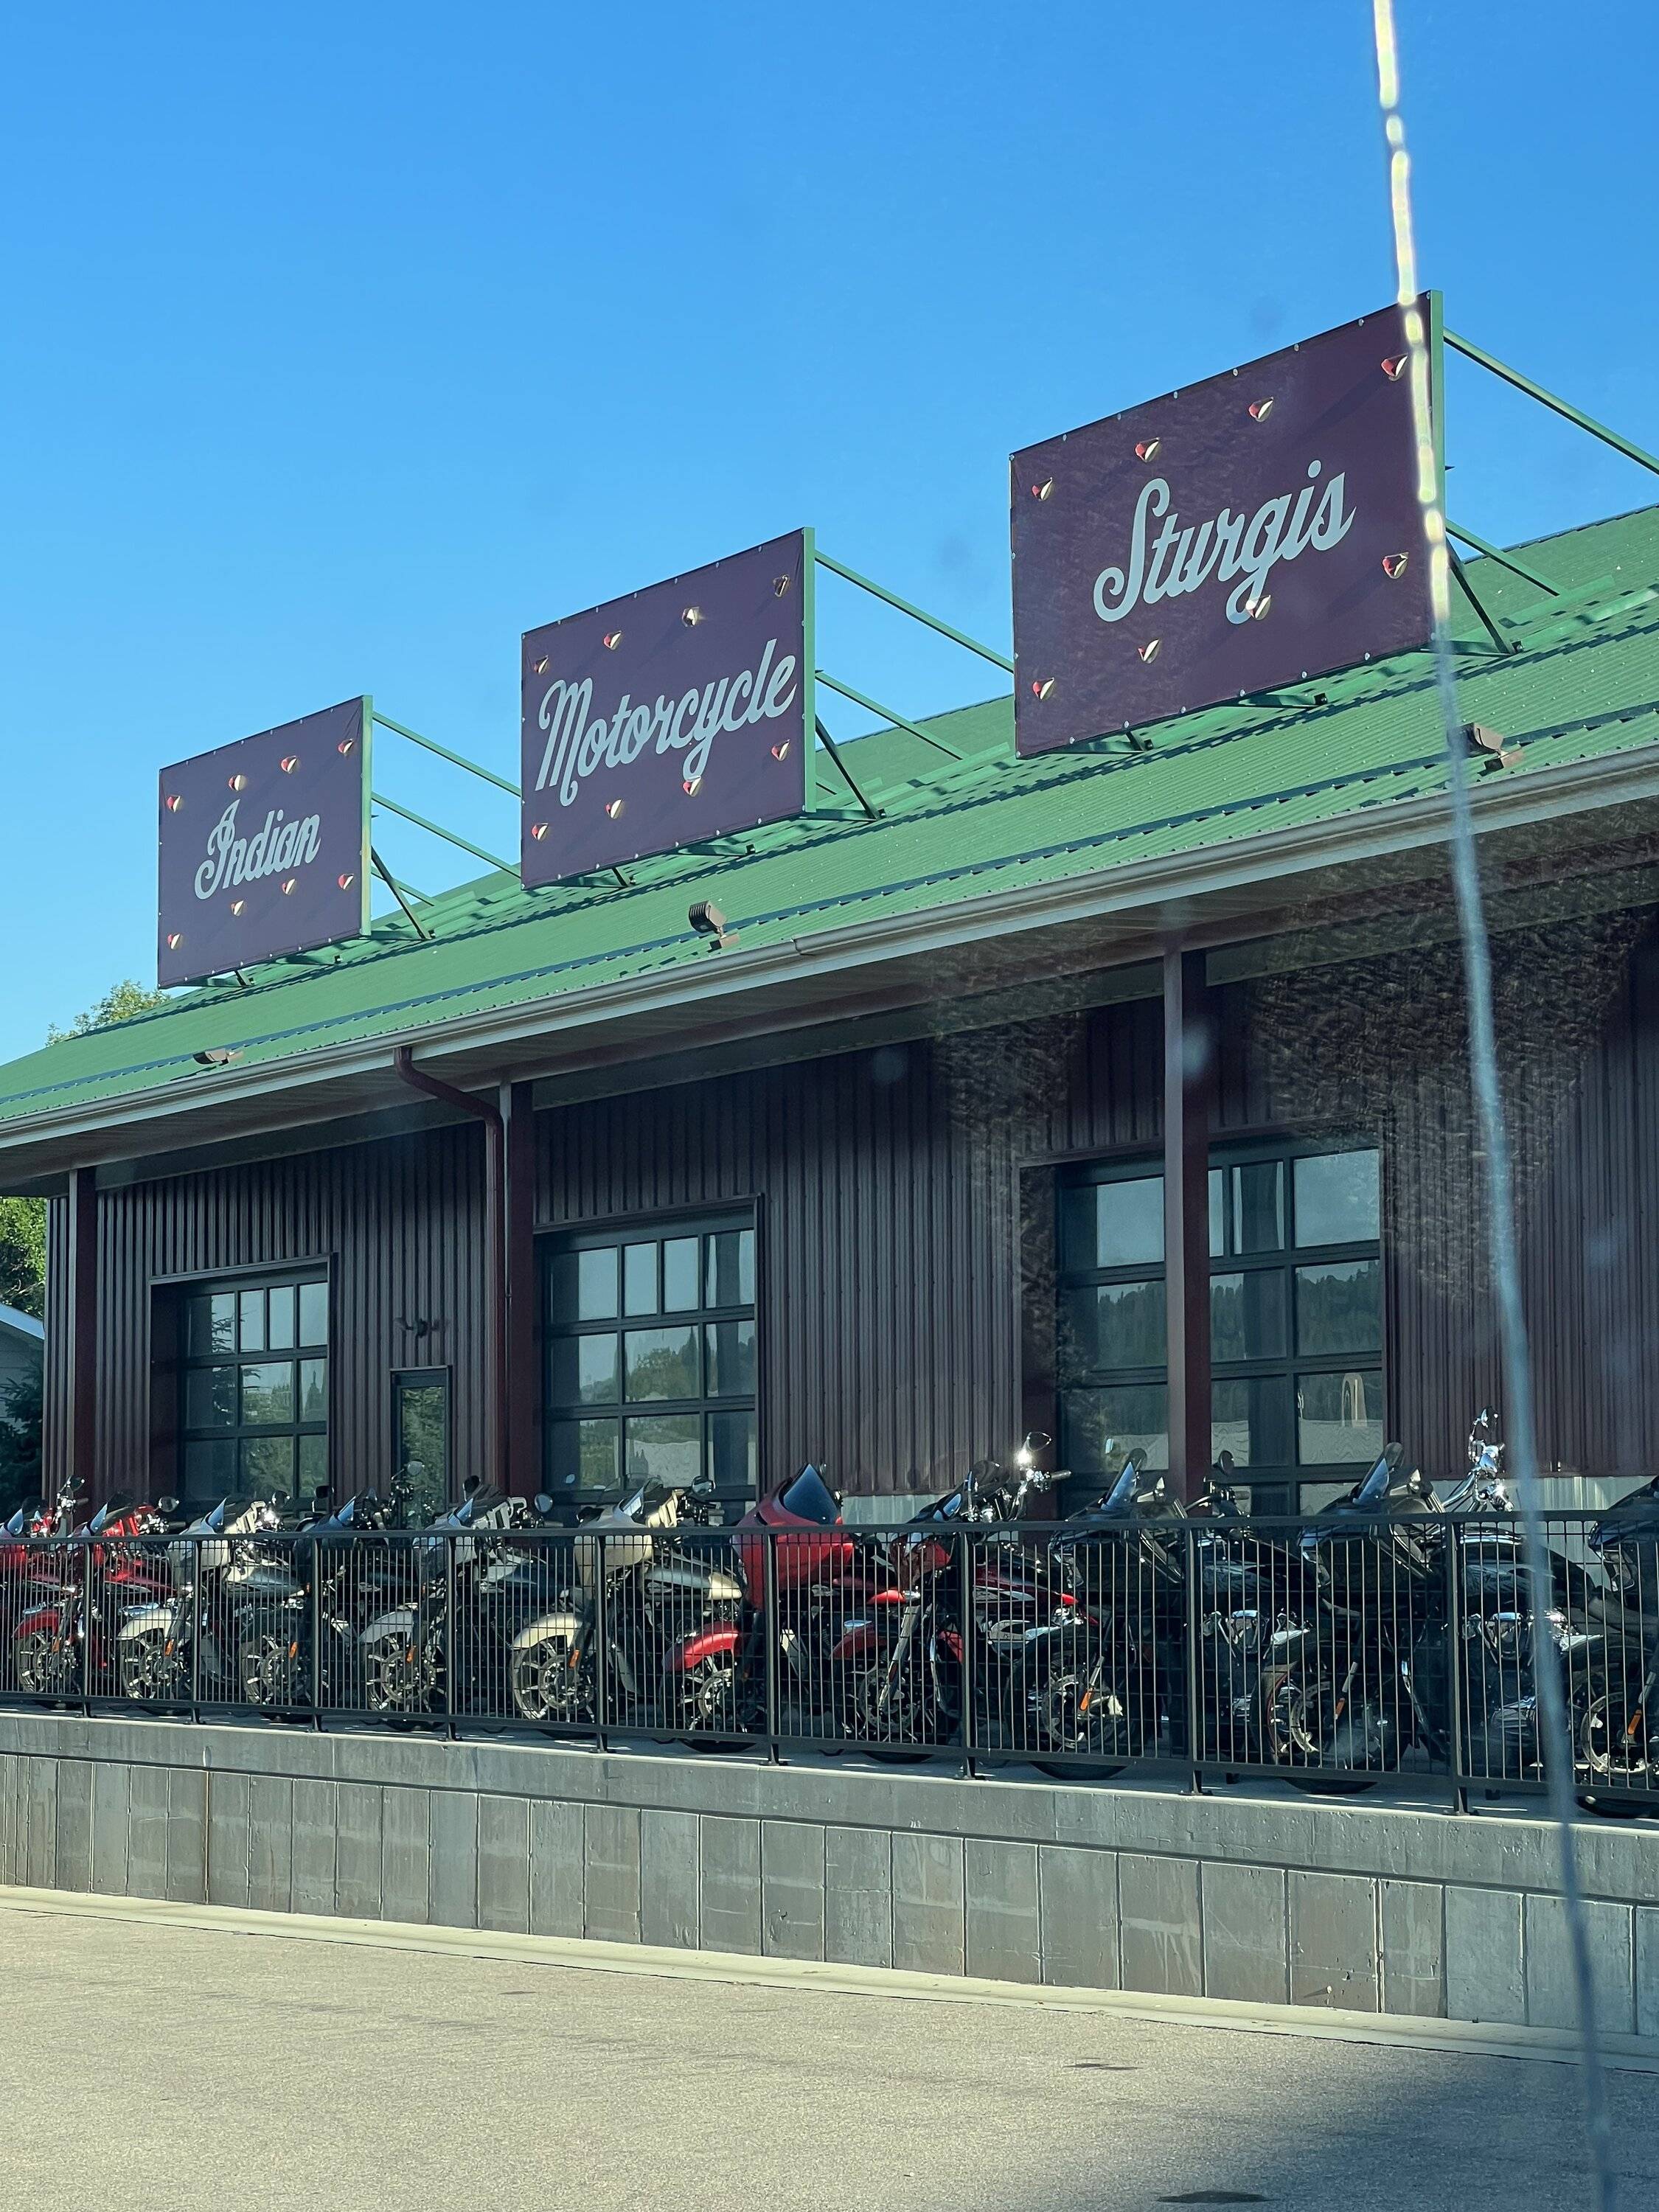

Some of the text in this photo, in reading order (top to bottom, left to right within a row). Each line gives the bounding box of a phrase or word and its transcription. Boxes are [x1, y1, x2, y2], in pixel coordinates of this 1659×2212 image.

[1093, 459, 1357, 625] Sturgis
[535, 639, 797, 807] Motorcycle
[194, 799, 321, 900] Indian
